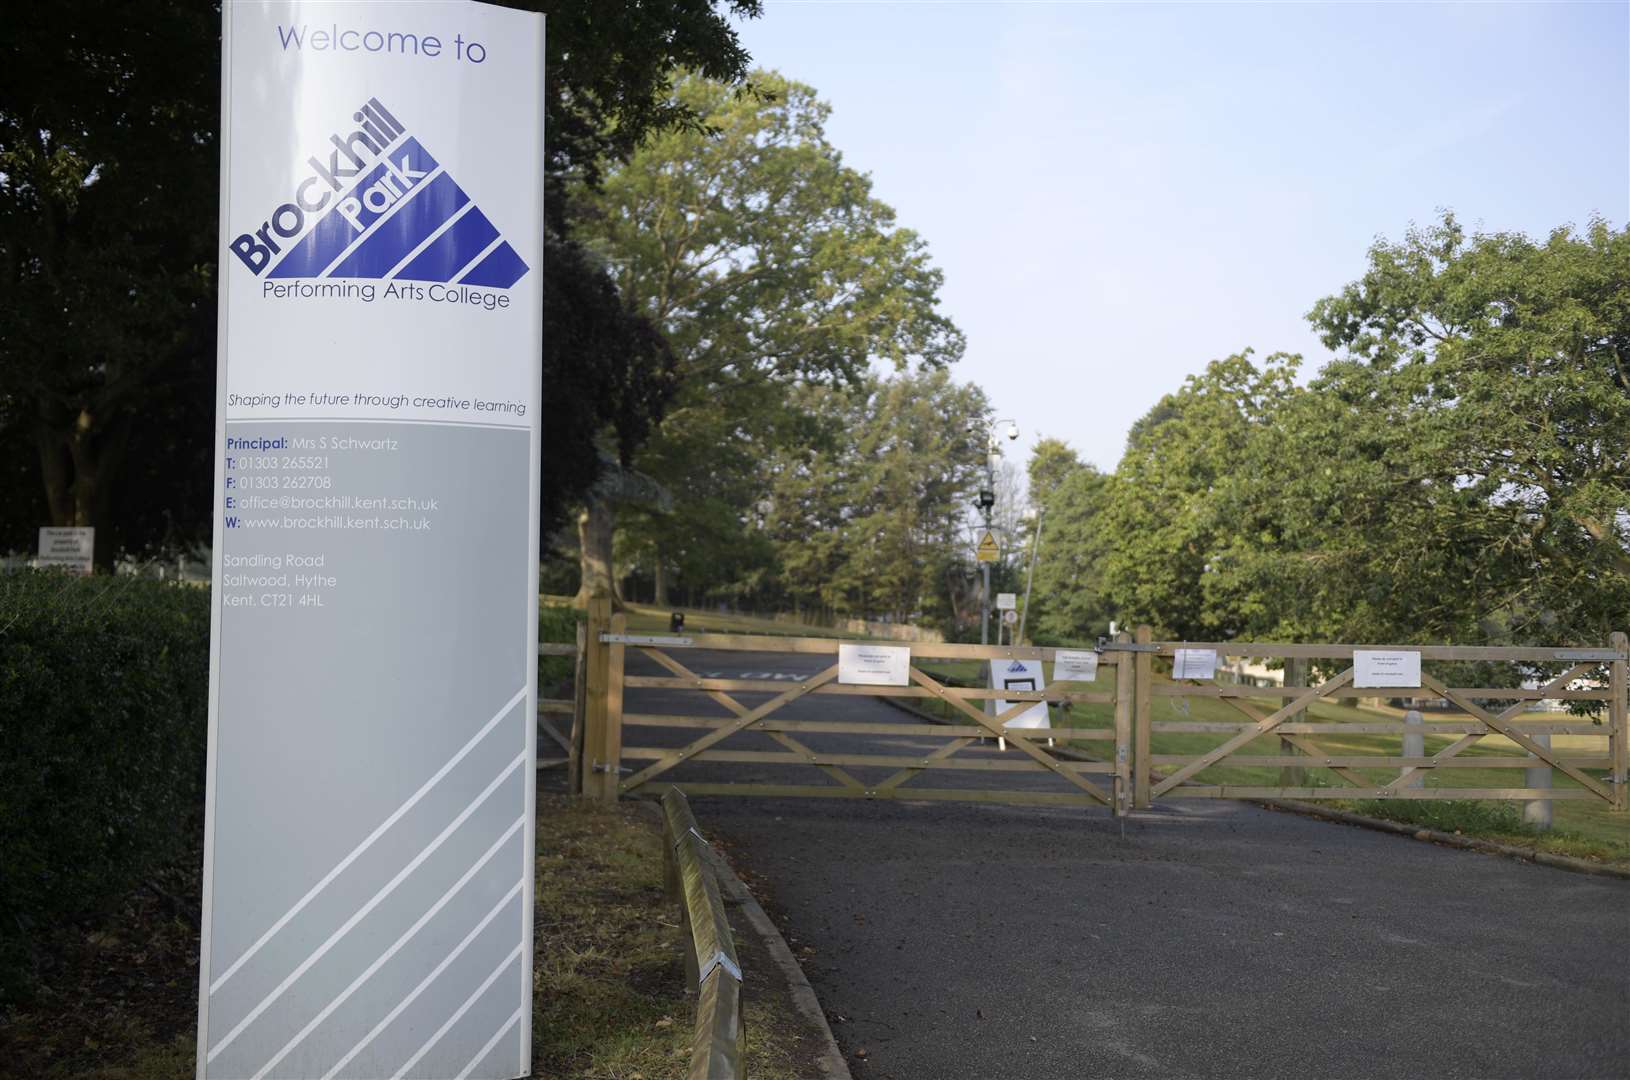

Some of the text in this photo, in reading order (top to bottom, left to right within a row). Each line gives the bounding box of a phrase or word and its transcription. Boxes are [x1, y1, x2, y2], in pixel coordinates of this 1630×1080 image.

[278, 24, 486, 63] Welcome to
[229, 97, 406, 276] Brockhill
[336, 154, 428, 232] Park
[263, 281, 510, 310] Performing Arts College
[228, 393, 526, 415] Shaping the future through creative learning
[227, 437, 398, 452] Principal: Mrs S Schwartz
[226, 457, 329, 469] T: 01303 265521
[226, 477, 331, 489] F: 01303 262708
[226, 496, 439, 510] E: office@brockhill.kent.sch.uk
[226, 516, 431, 530] W: www.brockhill.kent.sch.uk
[224, 554, 324, 569] Sandling Road
[224, 574, 336, 589] Saltwood, Hythe
[260, 594, 293, 607] CT21
[299, 594, 324, 607] 4HL
